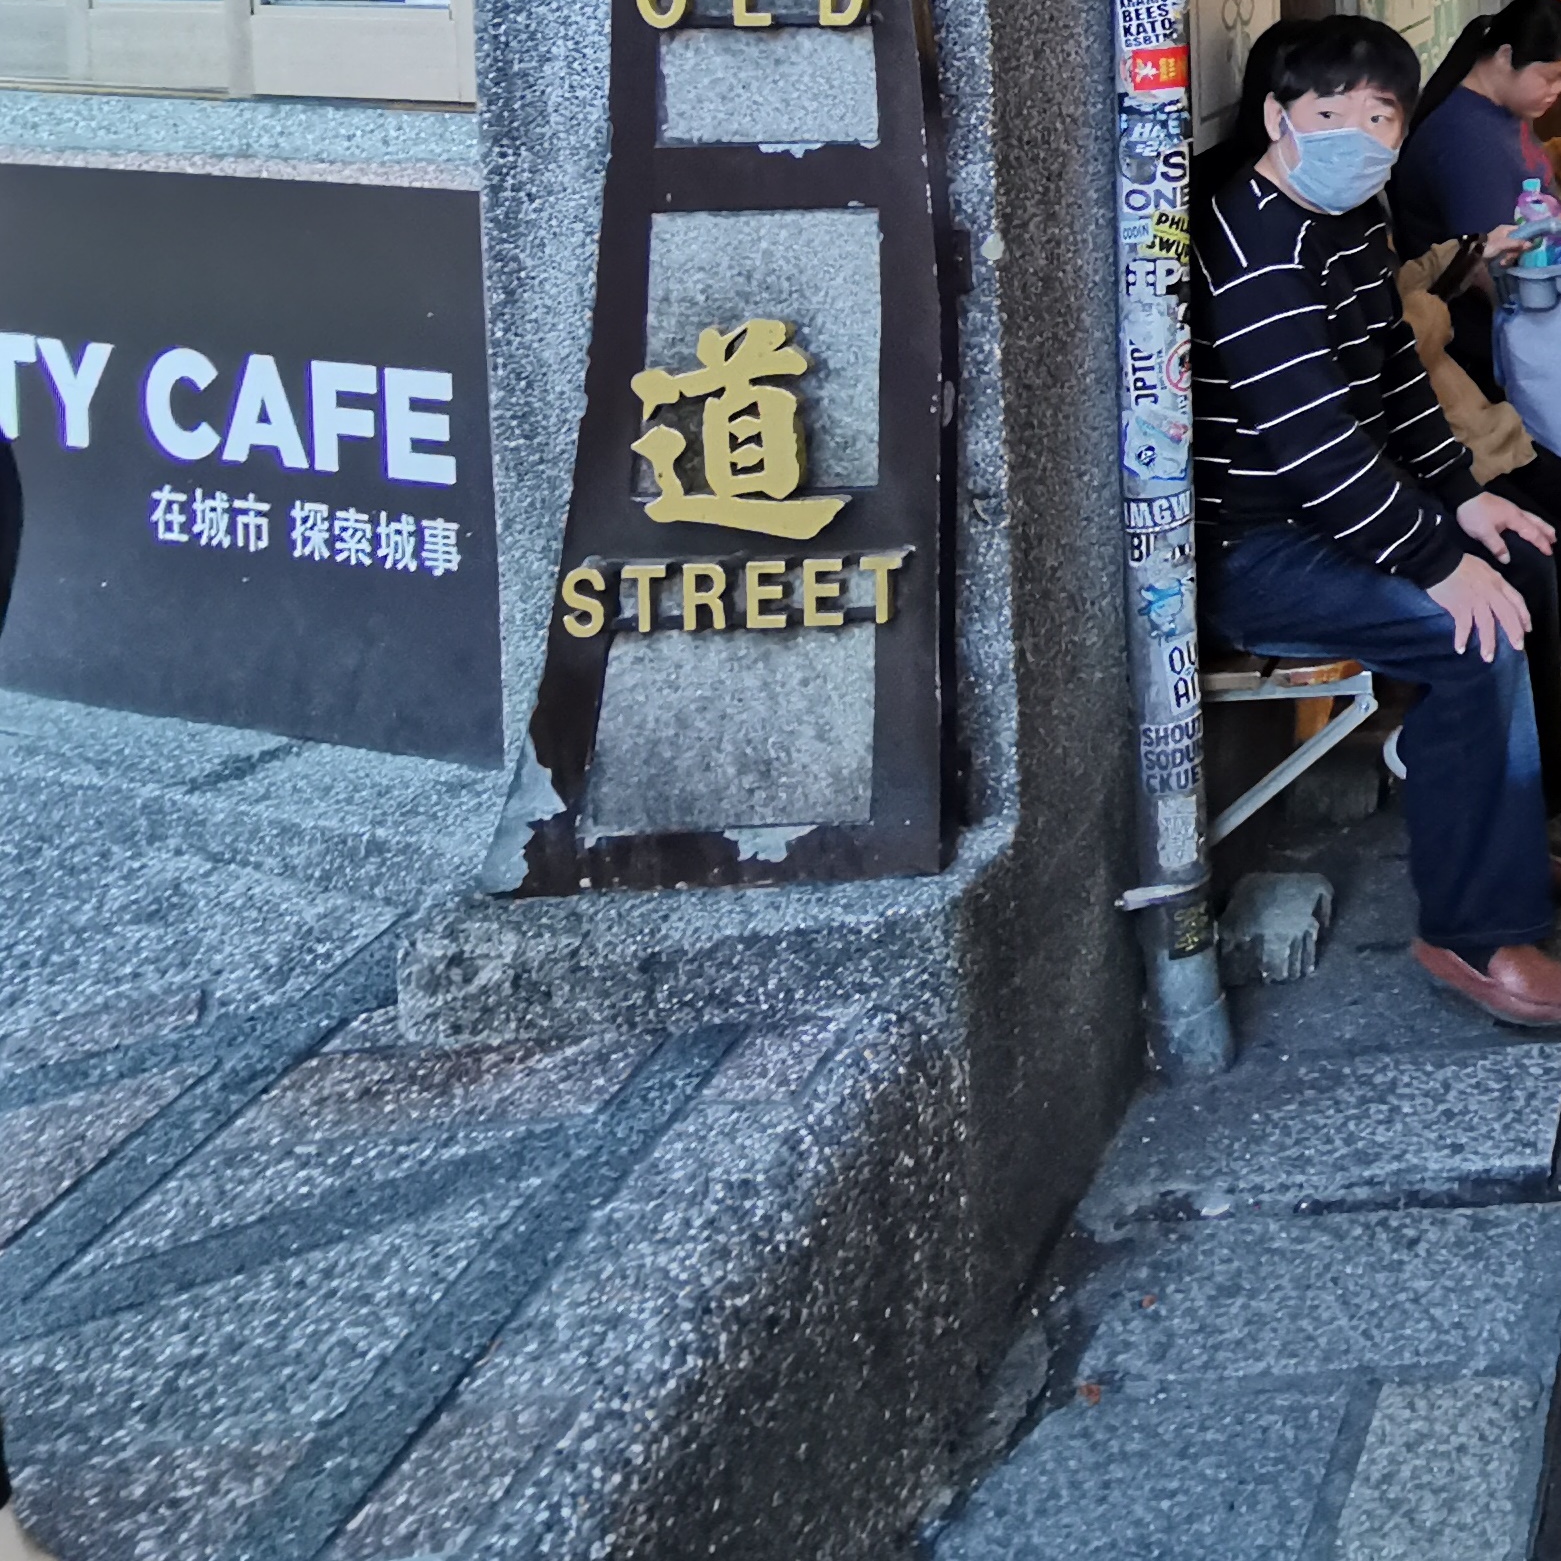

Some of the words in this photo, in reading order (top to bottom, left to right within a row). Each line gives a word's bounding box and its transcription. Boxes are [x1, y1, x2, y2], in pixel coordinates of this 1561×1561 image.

[1121, 2, 1170, 24] BEES
[1122, 17, 1174, 39] KATO
[143, 346, 458, 486] CAFE
[150, 484, 271, 552] 在城市
[289, 499, 463, 577] 探索城事
[561, 555, 903, 639] STREET
